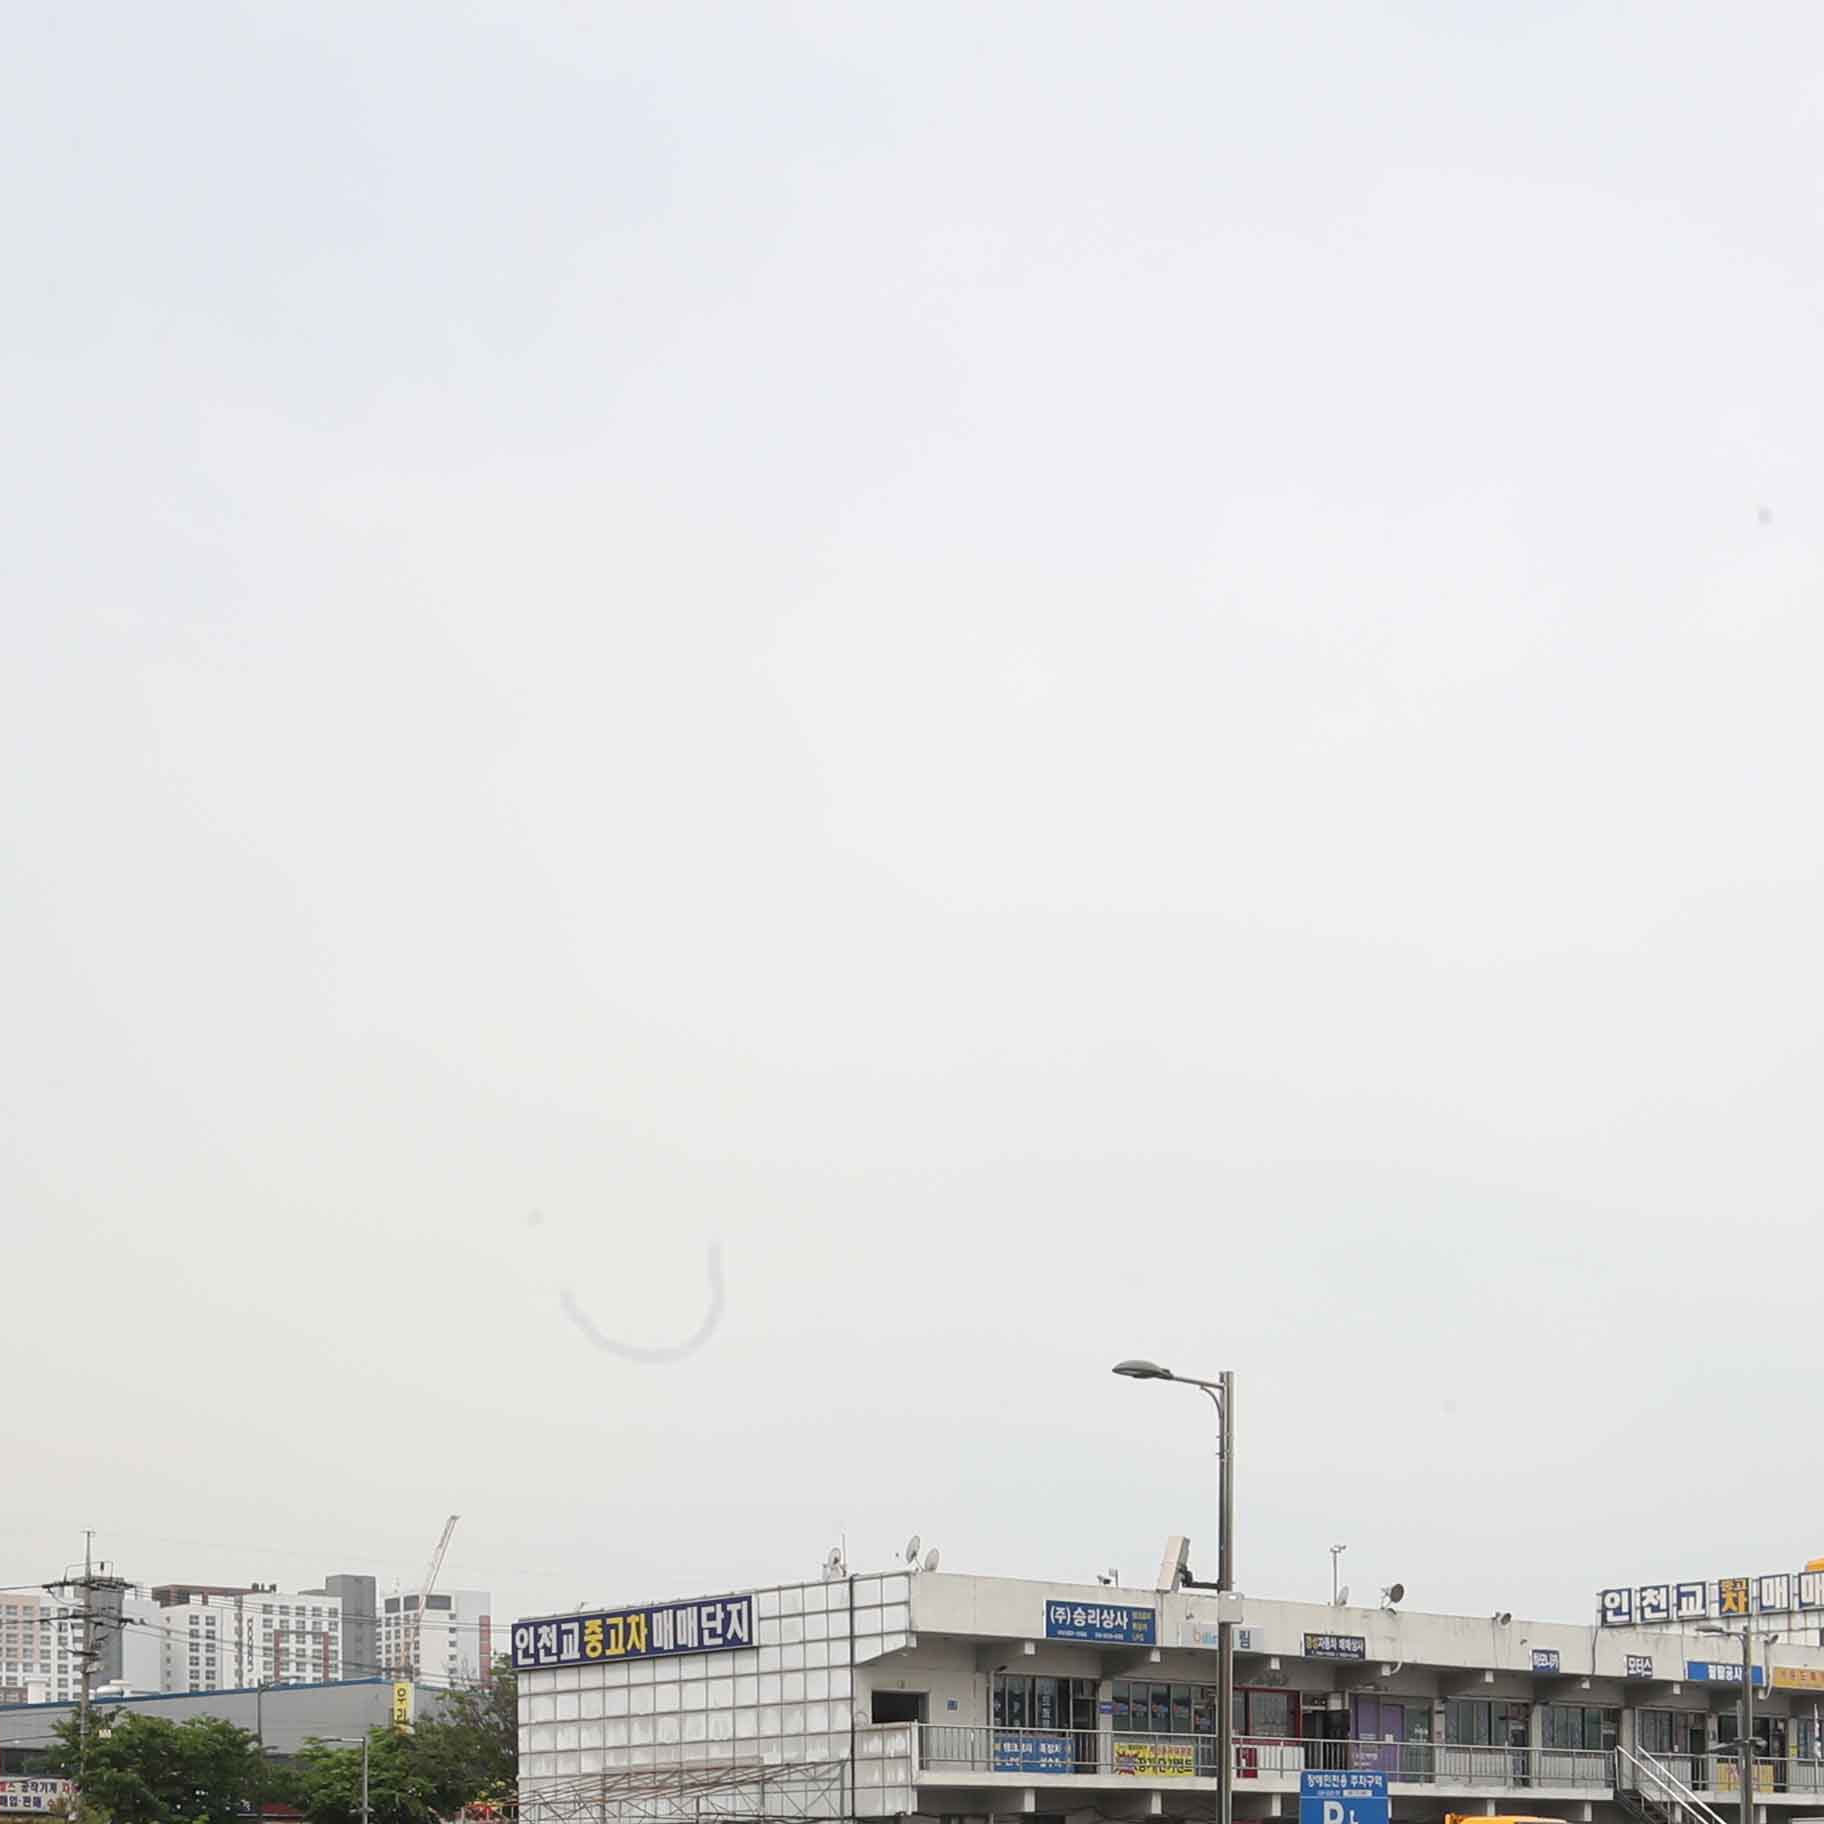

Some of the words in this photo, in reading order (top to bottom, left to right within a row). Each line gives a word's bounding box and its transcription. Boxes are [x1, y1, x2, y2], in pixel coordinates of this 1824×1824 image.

[1603, 1586, 1705, 1624] 인천교
[515, 1621, 581, 1666] 인천교
[583, 1613, 648, 1658] 중고차
[651, 1600, 749, 1650] 매매단지
[1628, 1656, 1653, 1676] 모터스
